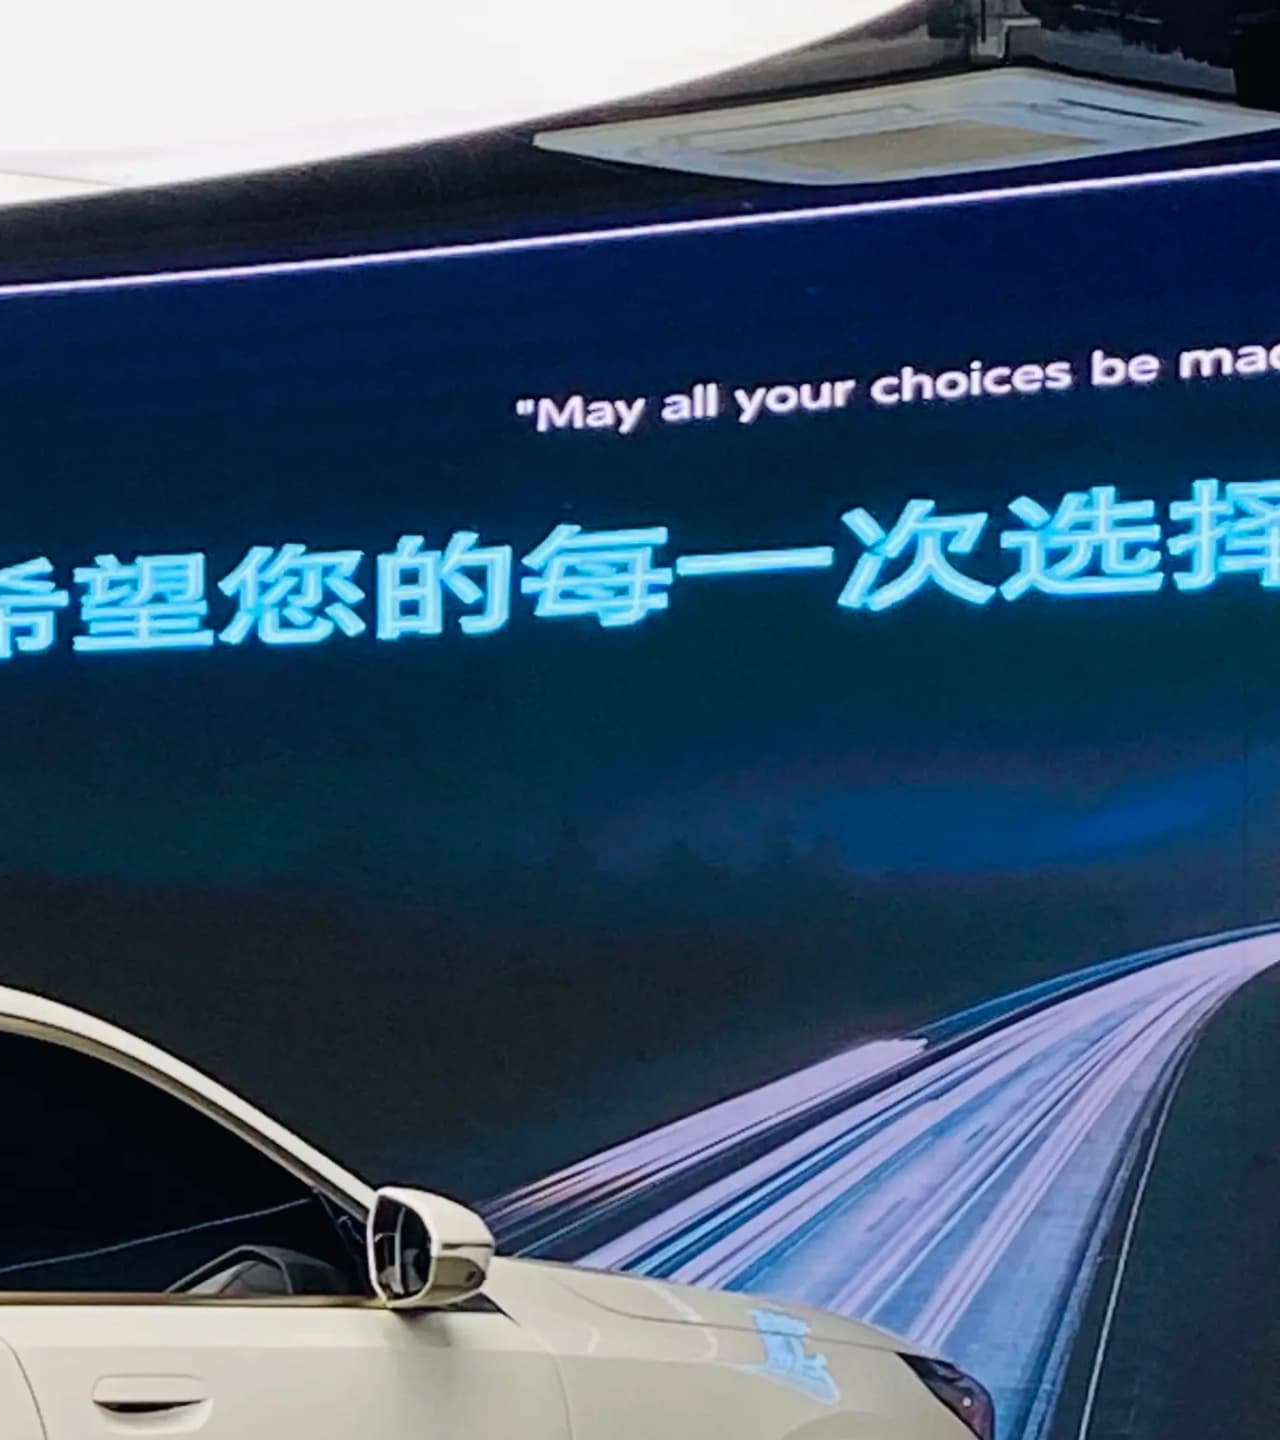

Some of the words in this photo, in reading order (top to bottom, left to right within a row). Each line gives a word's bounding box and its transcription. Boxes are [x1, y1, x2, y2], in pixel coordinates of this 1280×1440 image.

[515, 394, 646, 435] "May
[661, 382, 720, 423] all
[733, 378, 857, 424] your
[870, 360, 1072, 405] choices
[1090, 349, 1161, 387] be
